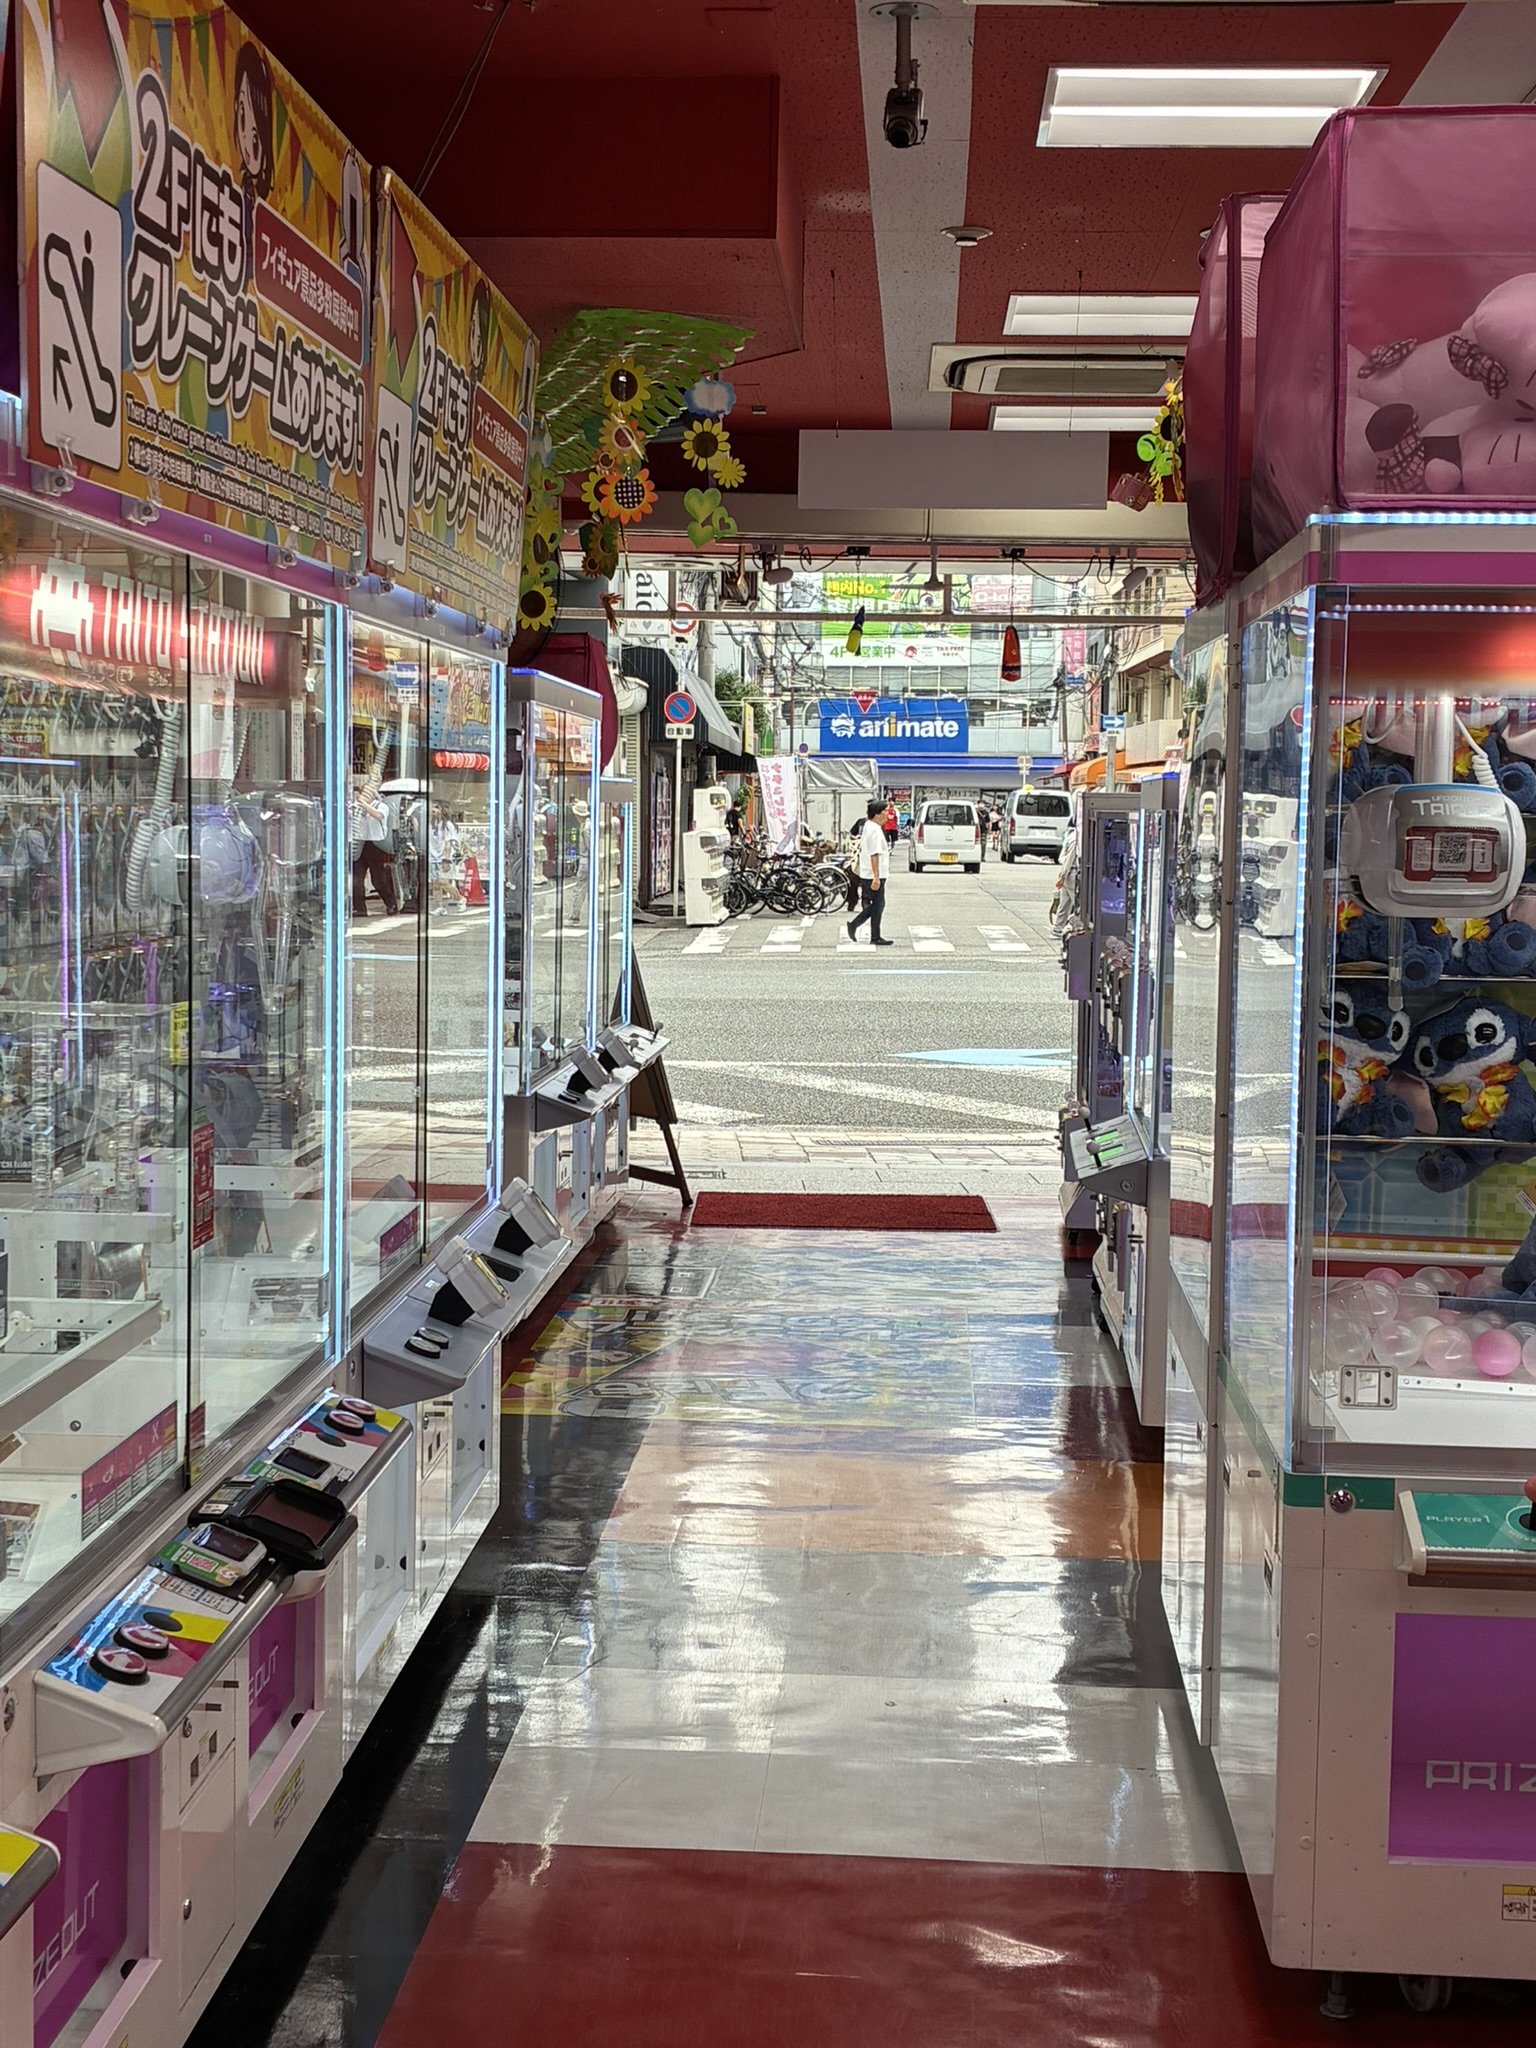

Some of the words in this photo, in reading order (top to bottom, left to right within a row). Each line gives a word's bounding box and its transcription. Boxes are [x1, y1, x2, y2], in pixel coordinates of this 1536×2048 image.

[134, 78, 244, 292] 2Fにも
[418, 316, 470, 450] 2Fにも
[103, 571, 173, 669] TAITO
[859, 712, 959, 737] animate
